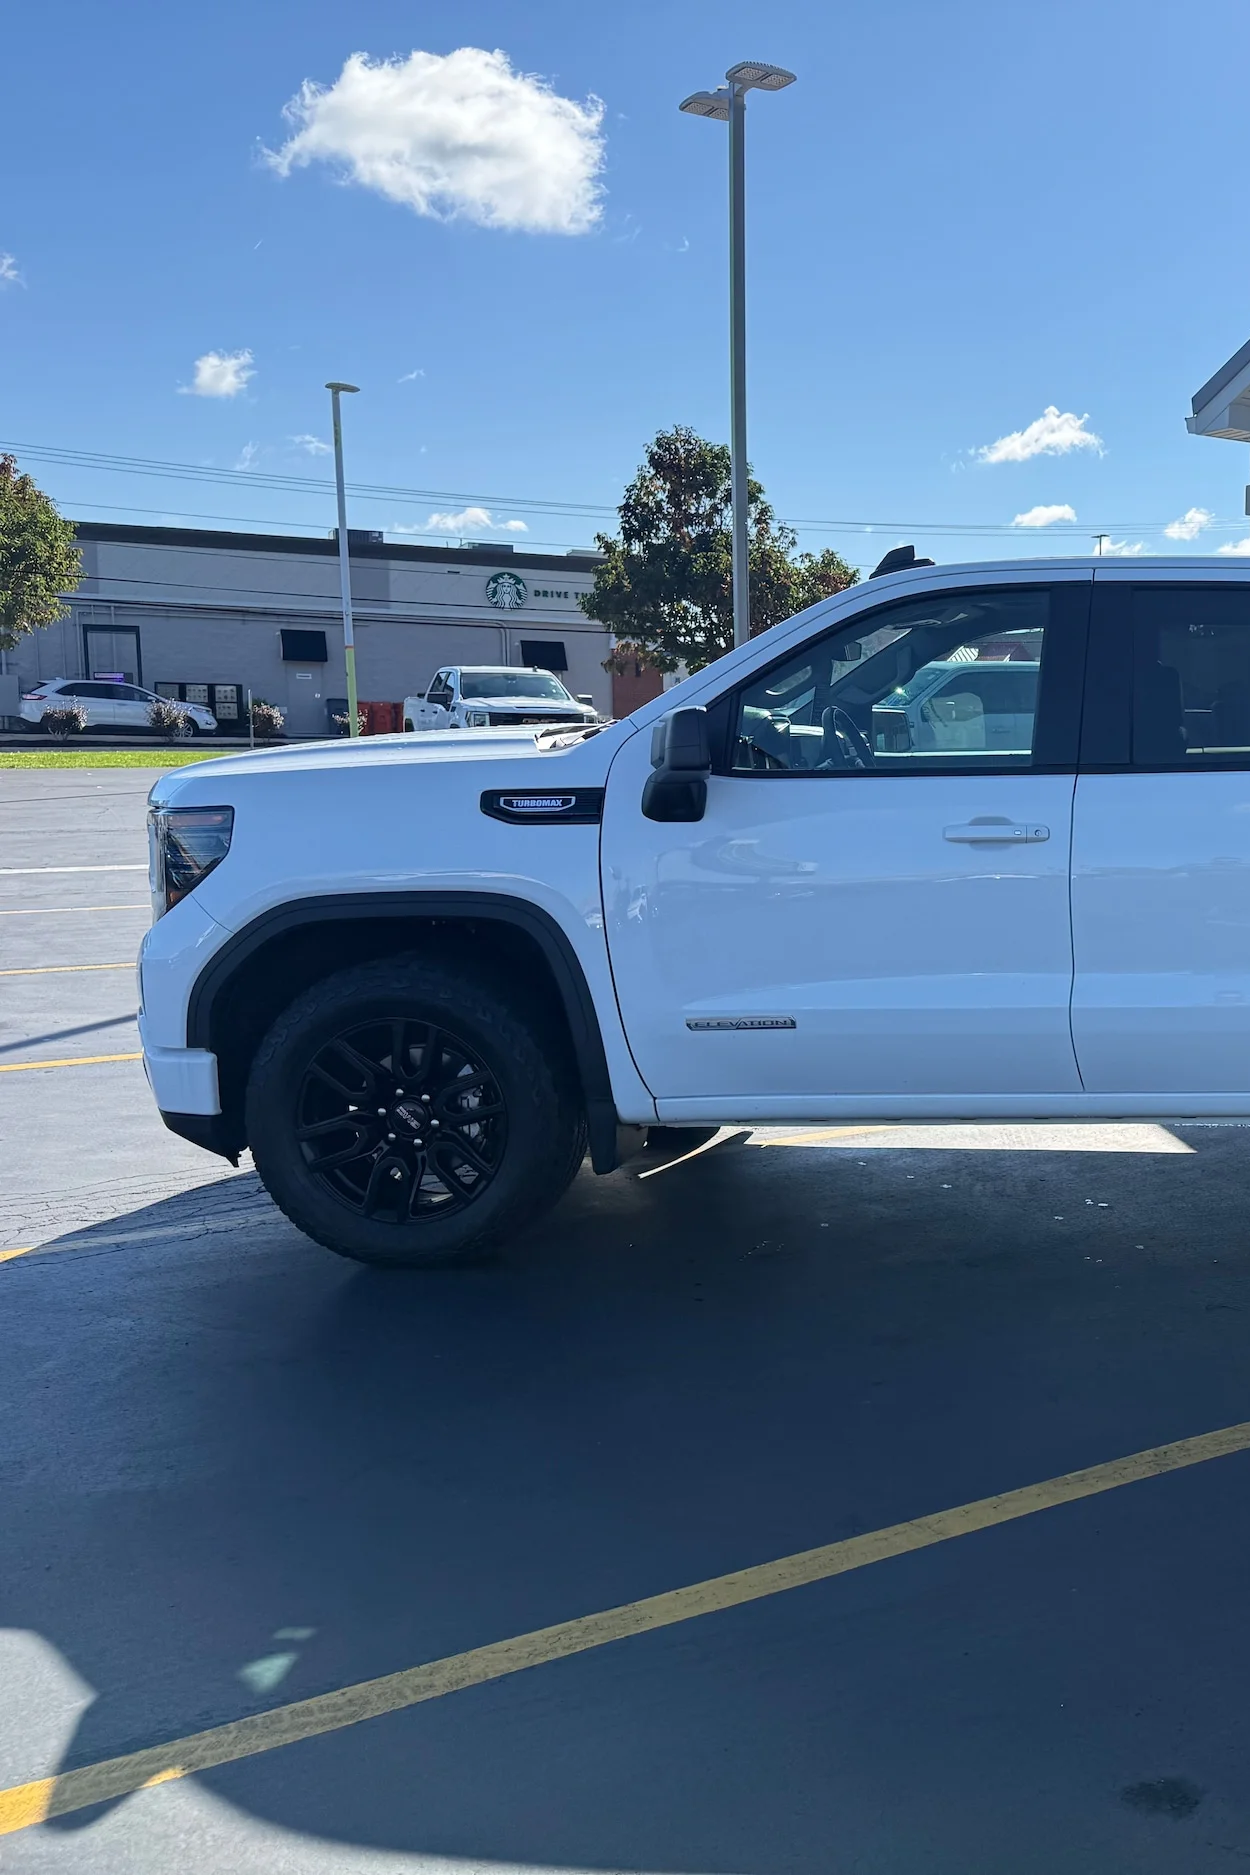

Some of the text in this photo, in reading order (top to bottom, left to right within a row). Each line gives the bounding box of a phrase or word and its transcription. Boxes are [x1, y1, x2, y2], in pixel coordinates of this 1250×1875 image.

[533, 589, 569, 599] DRIVE
[512, 799, 563, 808] TURBOMAX
[692, 1019, 788, 1029] ELEVATION
